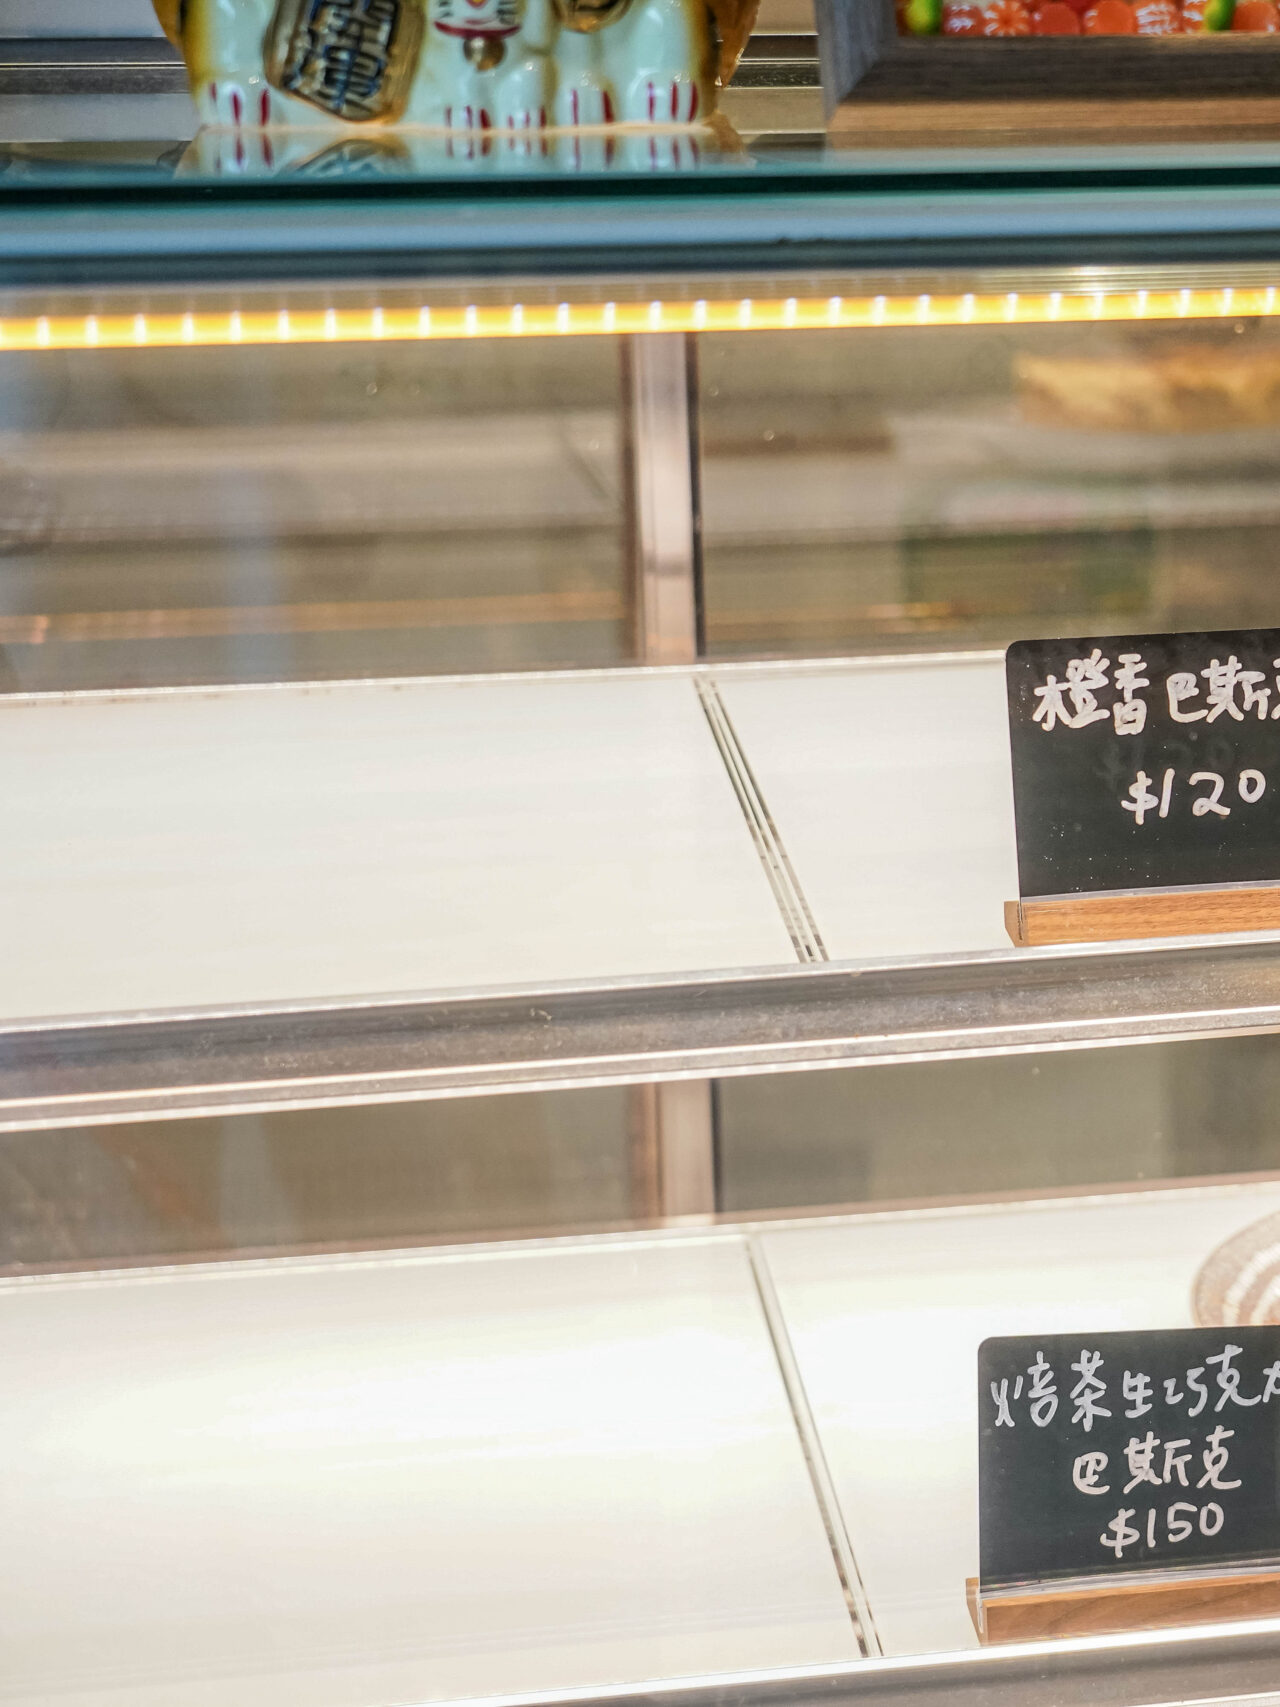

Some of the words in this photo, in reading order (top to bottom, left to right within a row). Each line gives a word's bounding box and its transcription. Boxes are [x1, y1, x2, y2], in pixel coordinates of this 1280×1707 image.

[1121, 768, 1266, 825] $120
[1072, 1425, 1242, 1494] 巴斯克
[1100, 1502, 1225, 1558] $150
